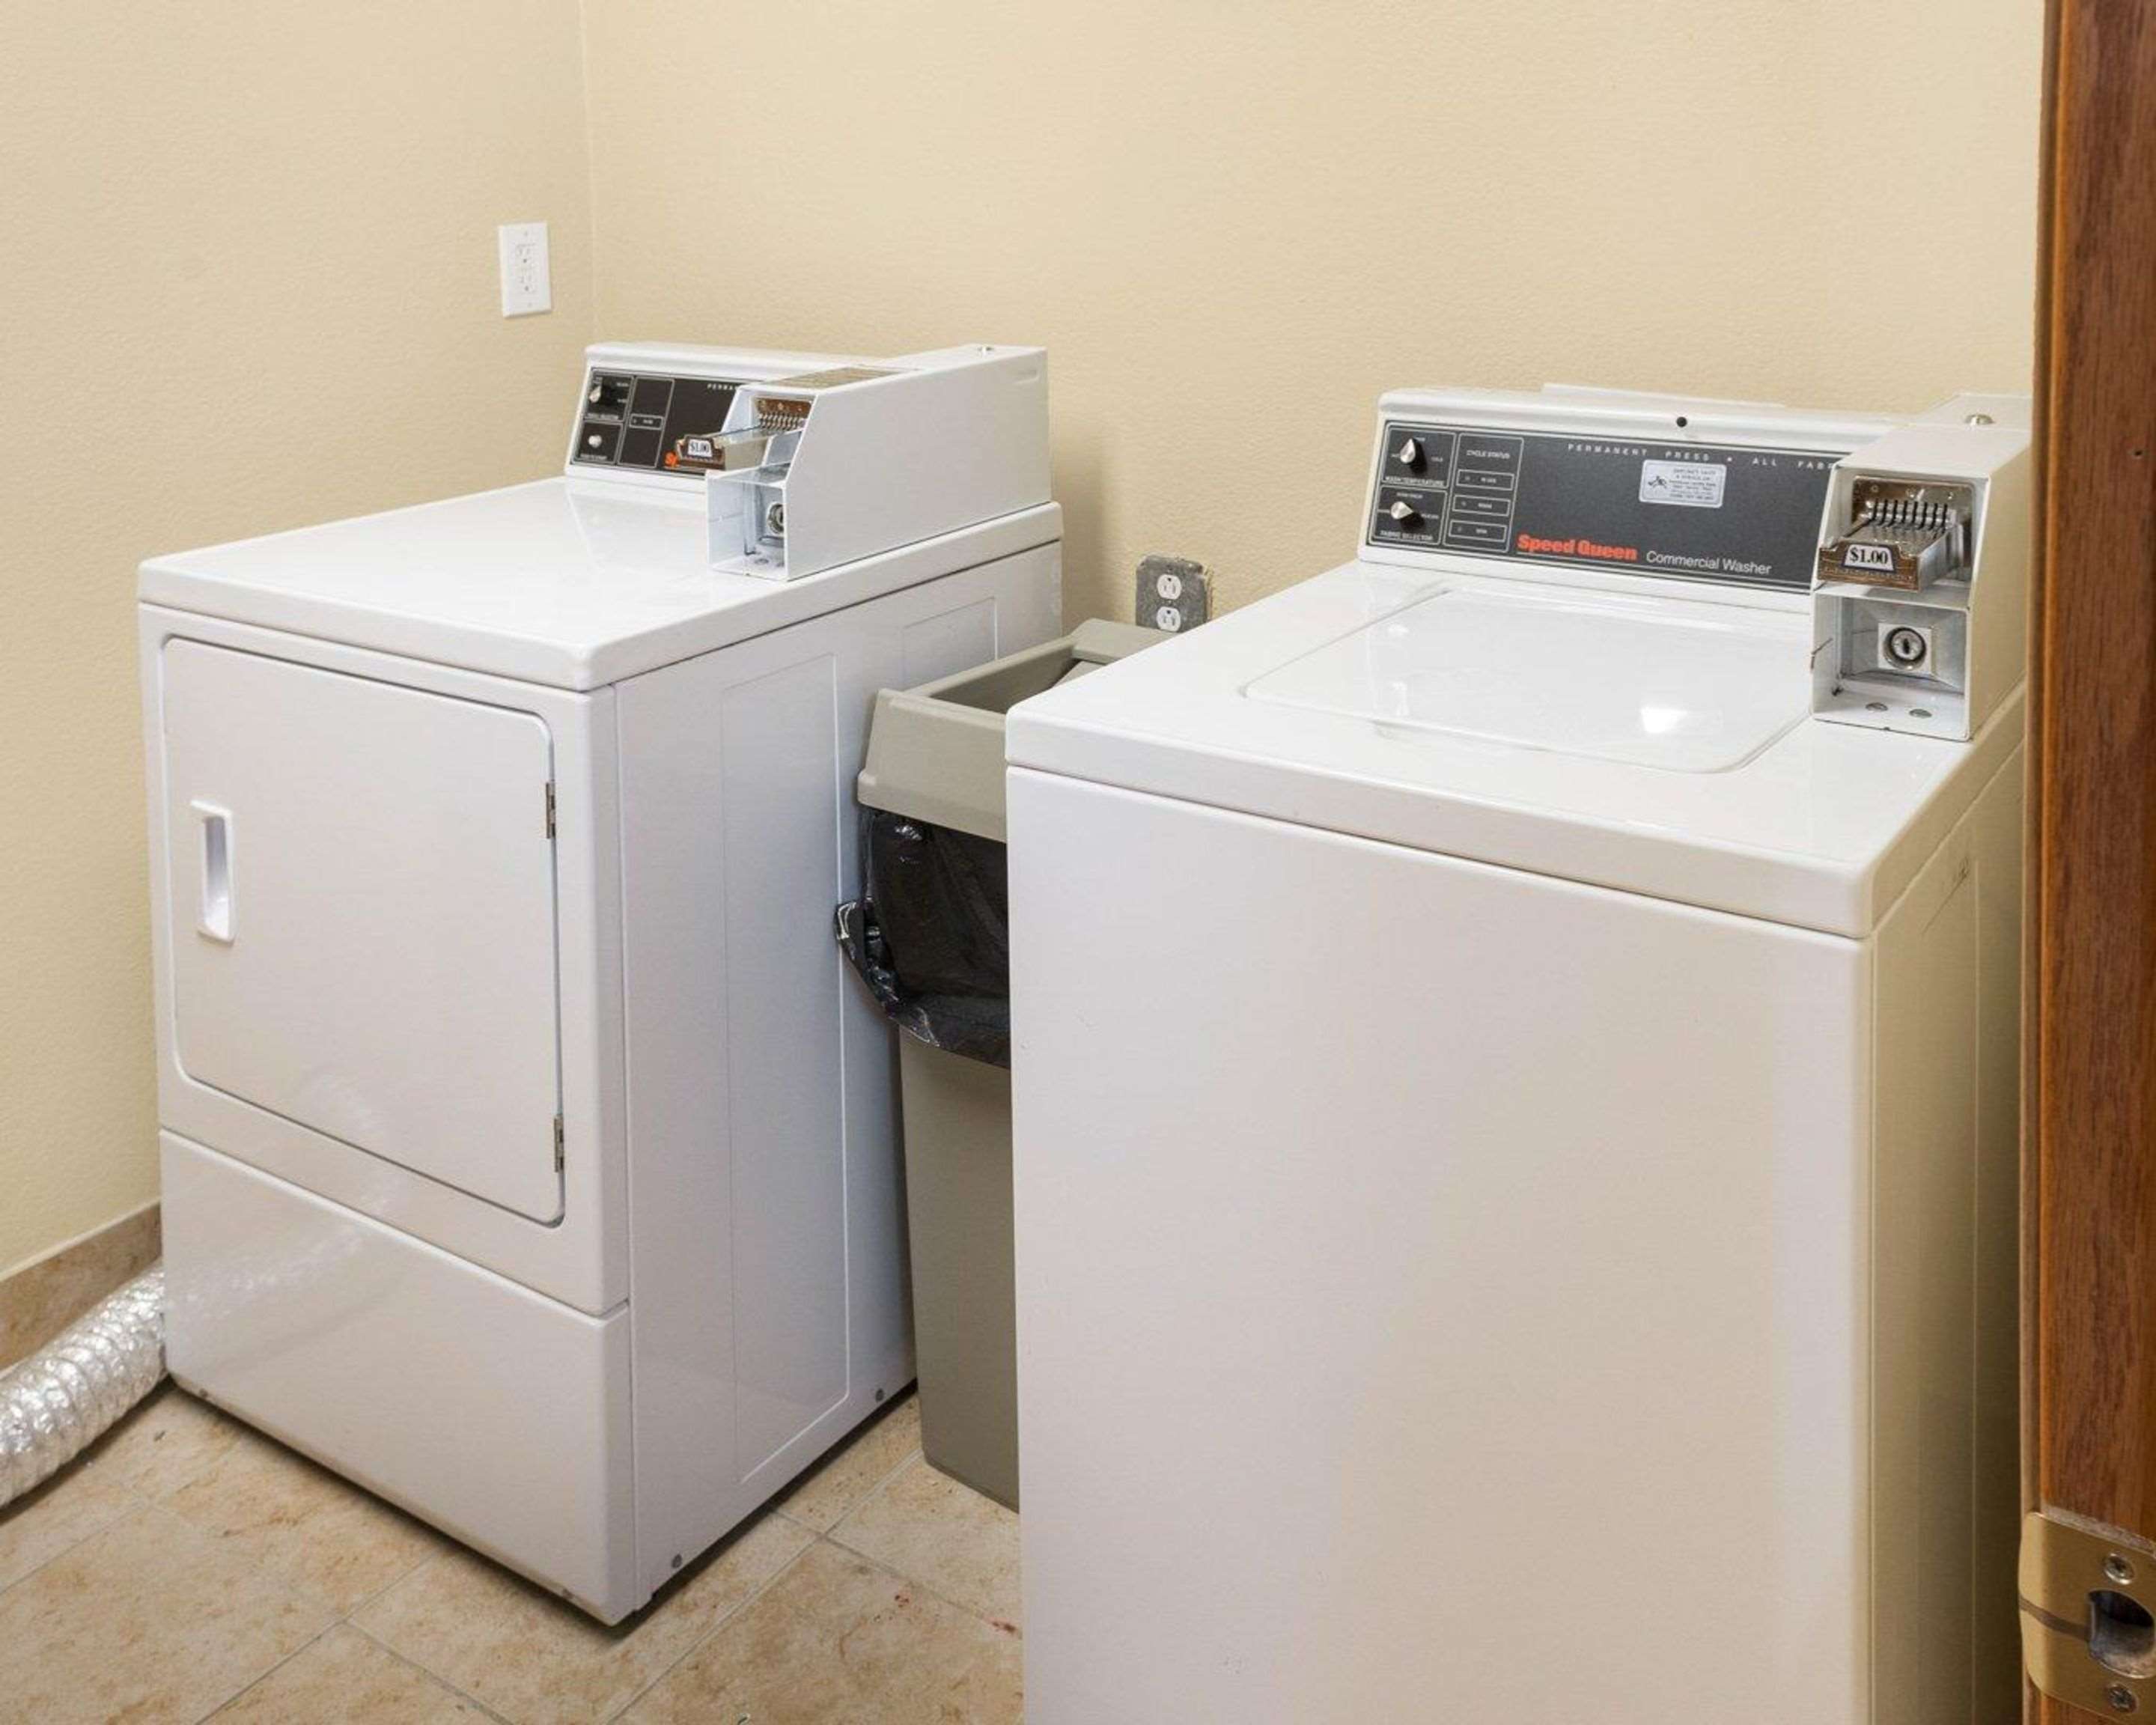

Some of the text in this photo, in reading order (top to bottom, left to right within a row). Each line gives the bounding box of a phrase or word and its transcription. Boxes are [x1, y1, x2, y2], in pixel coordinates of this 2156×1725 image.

[1568, 443, 1647, 455] PERMANENT
[1665, 451, 1710, 462] PRESS
[1752, 457, 1777, 466] ALL
[1517, 534, 1638, 560] Speed Queen
[1849, 546, 1889, 565] $1.00
[1646, 550, 1772, 575] Commercial Washer
